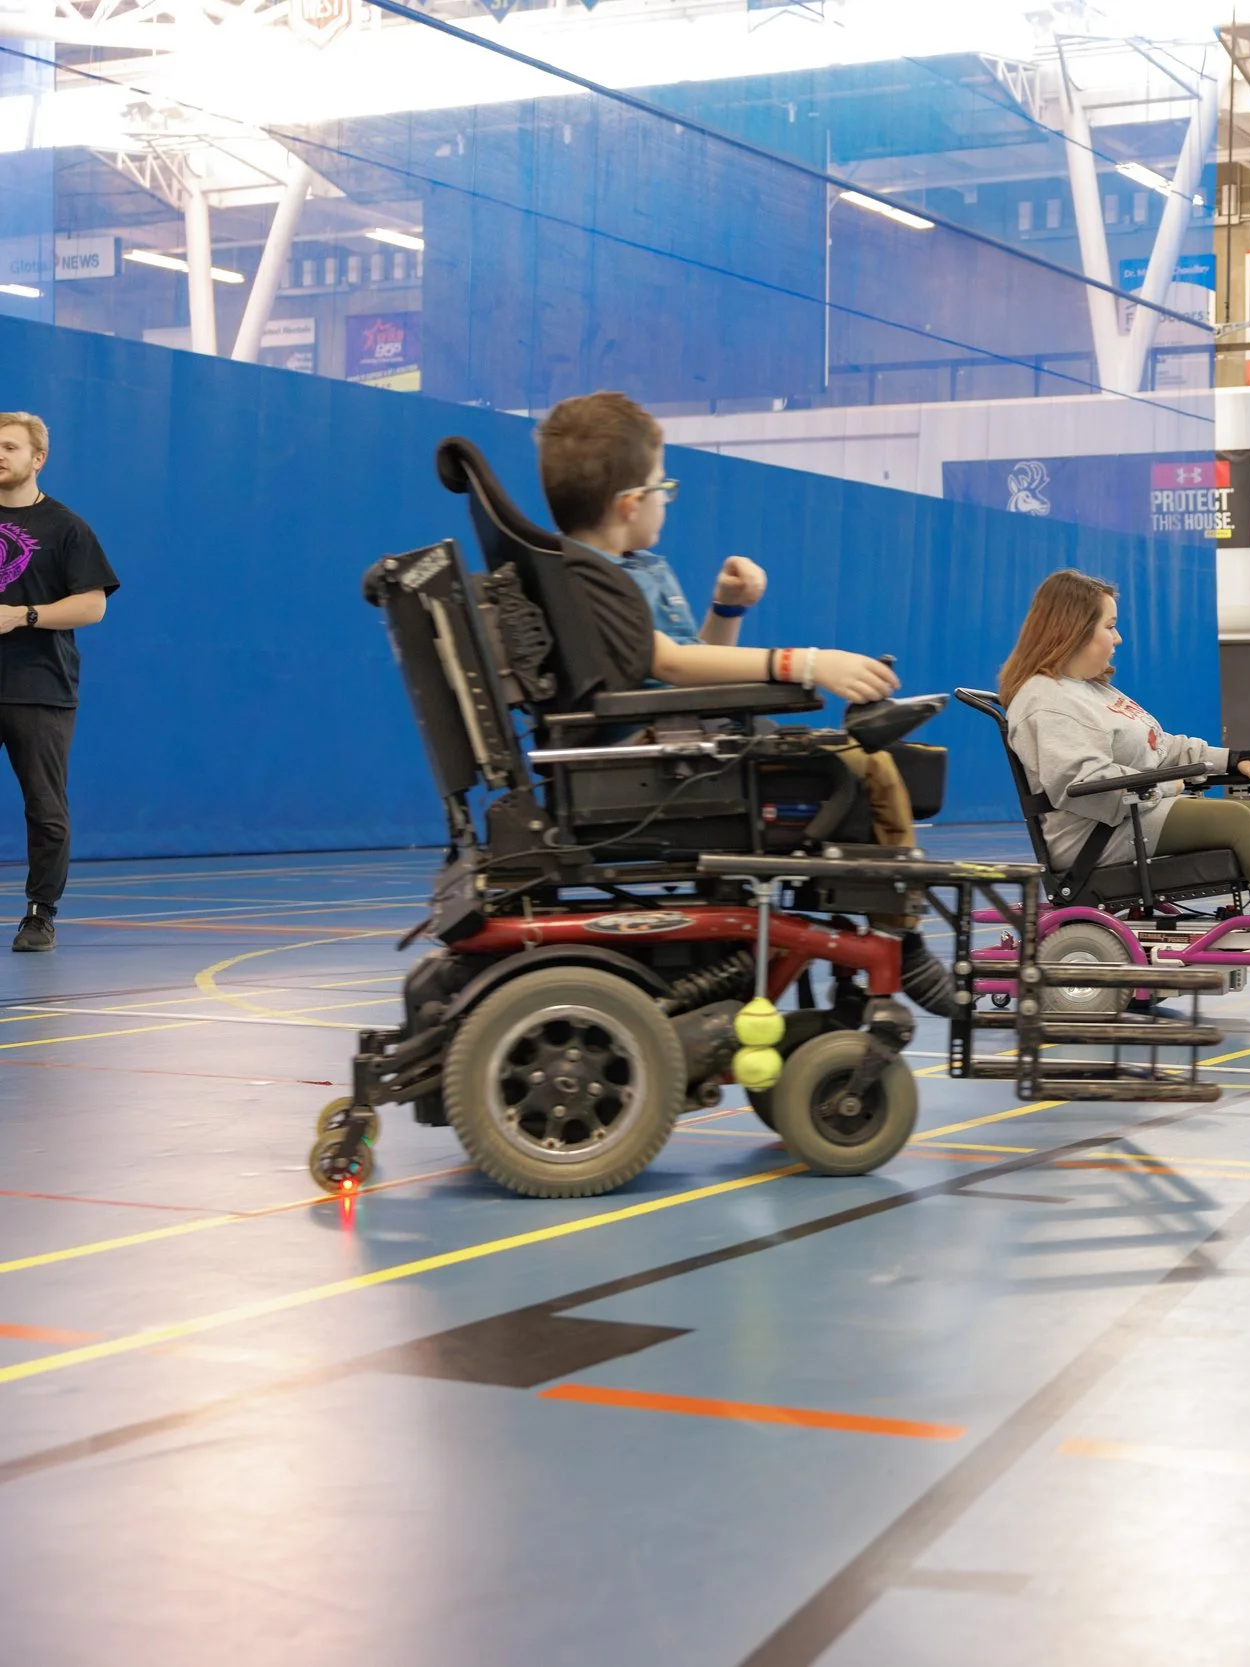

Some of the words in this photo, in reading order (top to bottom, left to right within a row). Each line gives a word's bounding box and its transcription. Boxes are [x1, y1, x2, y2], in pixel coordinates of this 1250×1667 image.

[9, 259, 53, 274] Global
[62, 253, 100, 270] NEWS
[1151, 489, 1229, 512] PROTECT
[1151, 514, 1181, 532] THIS
[1184, 512, 1236, 531] HOUSE.
